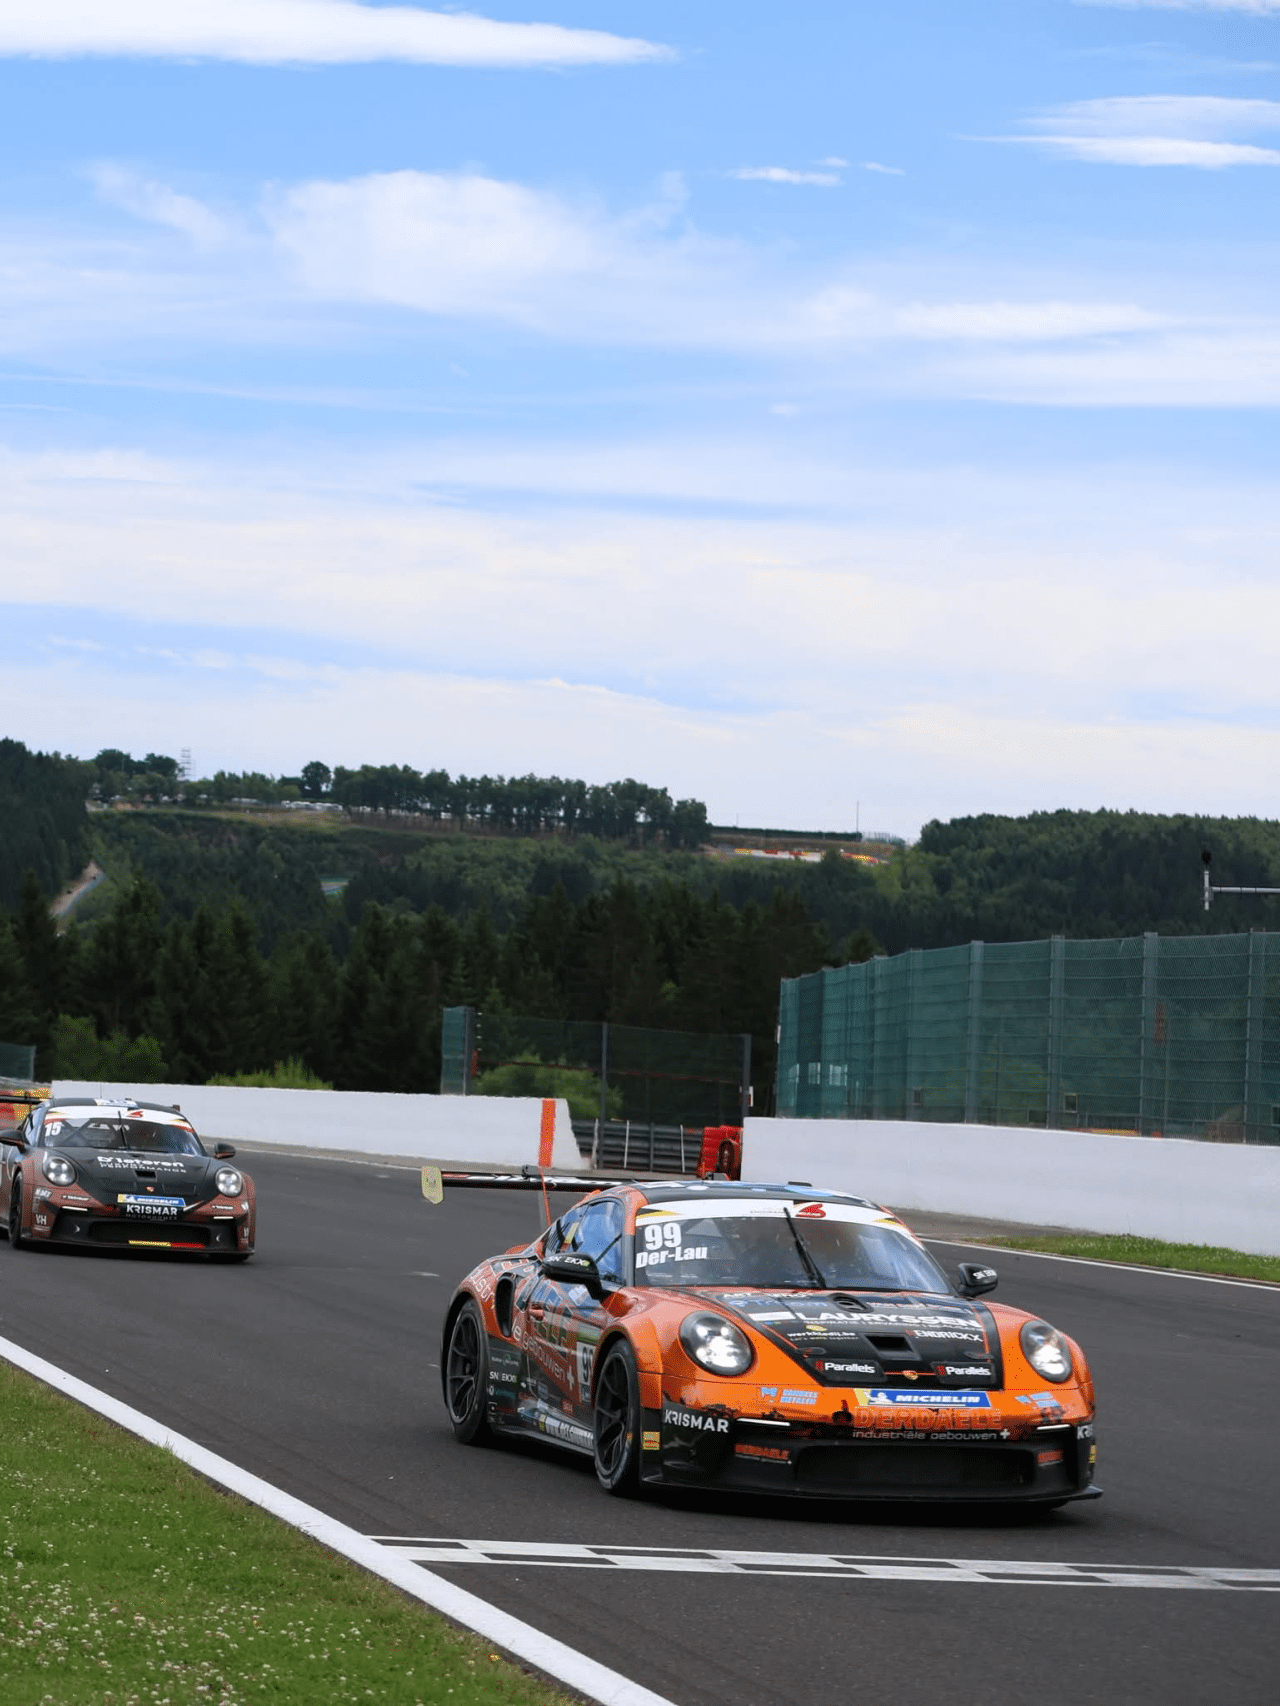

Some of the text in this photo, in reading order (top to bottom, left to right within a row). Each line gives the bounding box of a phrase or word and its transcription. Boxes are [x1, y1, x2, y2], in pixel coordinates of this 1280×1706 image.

[45, 1122, 64, 1137] 15
[126, 1204, 178, 1216] KRISMAR
[644, 1222, 682, 1251] 99
[635, 1246, 708, 1269] Der-Lau
[795, 1312, 983, 1328] LAURYSSEN
[825, 1362, 875, 1374] Parallels
[945, 1366, 991, 1376] Parallels
[895, 1395, 981, 1403] MICHELIN
[664, 1409, 729, 1433] KRISMAR
[854, 1407, 1002, 1430] DERDAELE
[852, 1430, 926, 1440] industriële
